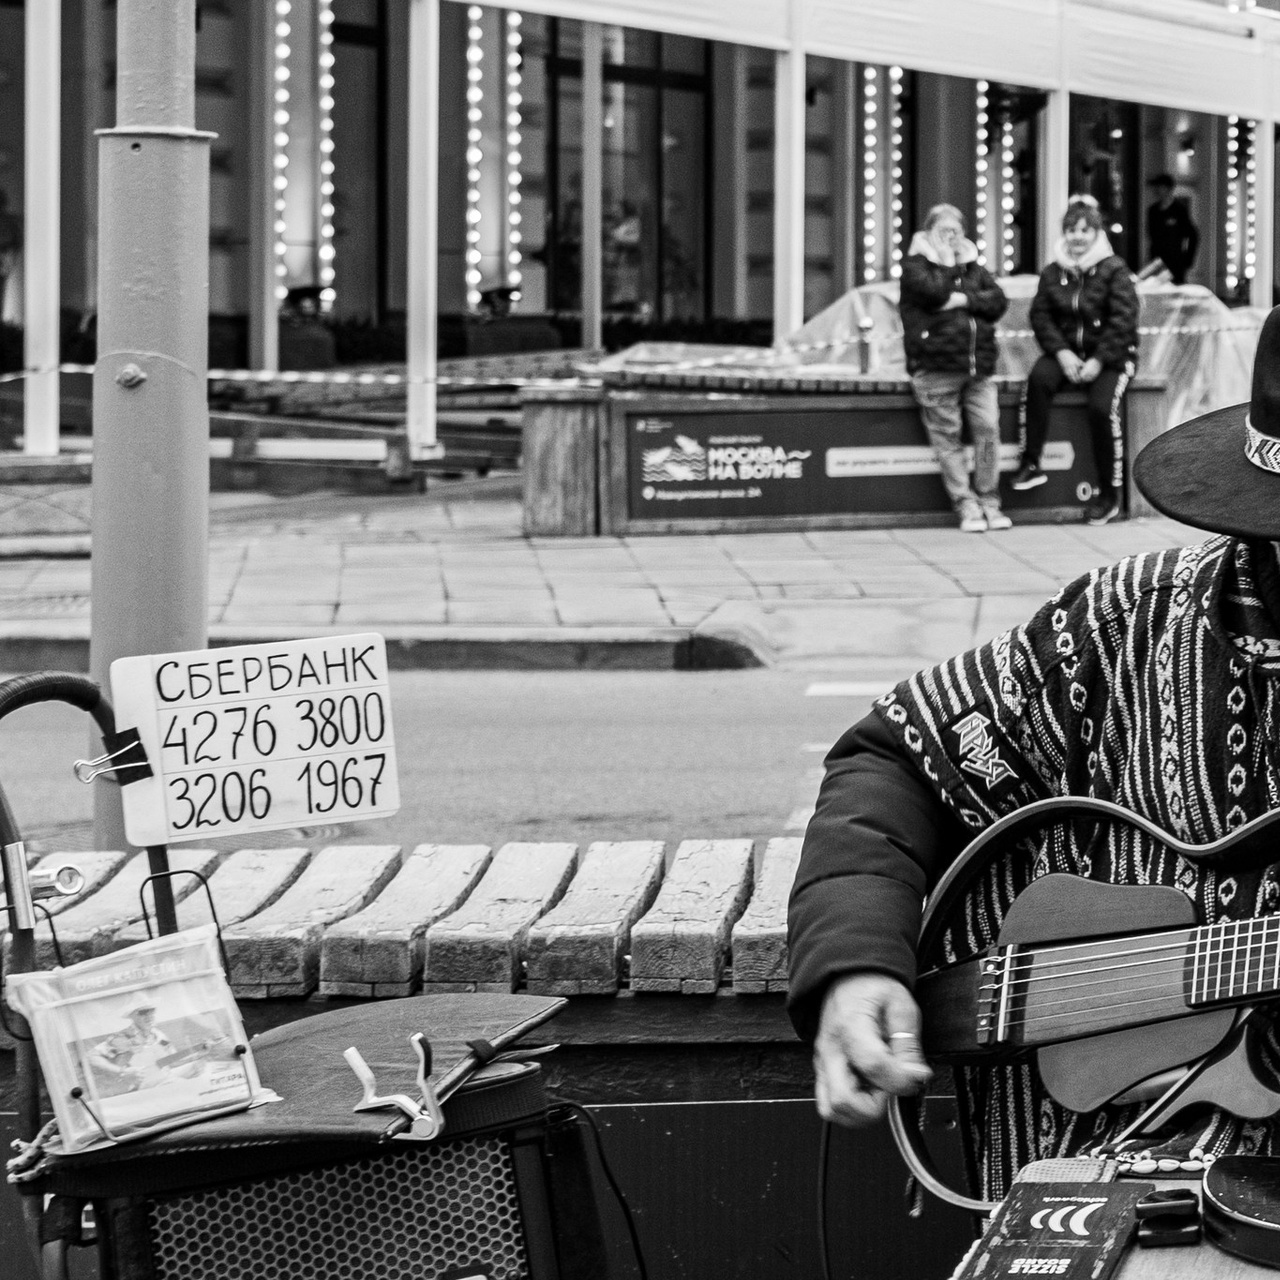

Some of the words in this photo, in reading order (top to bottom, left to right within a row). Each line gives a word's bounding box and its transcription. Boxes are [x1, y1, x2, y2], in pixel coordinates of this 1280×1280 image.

[155, 644, 378, 703] СБЕРБАНК
[161, 704, 277, 766] 4276
[295, 692, 385, 752] 3800
[169, 768, 272, 830] 3206
[297, 753, 386, 815] 1967
[1007, 1264, 1070, 1274] SIZZLE
